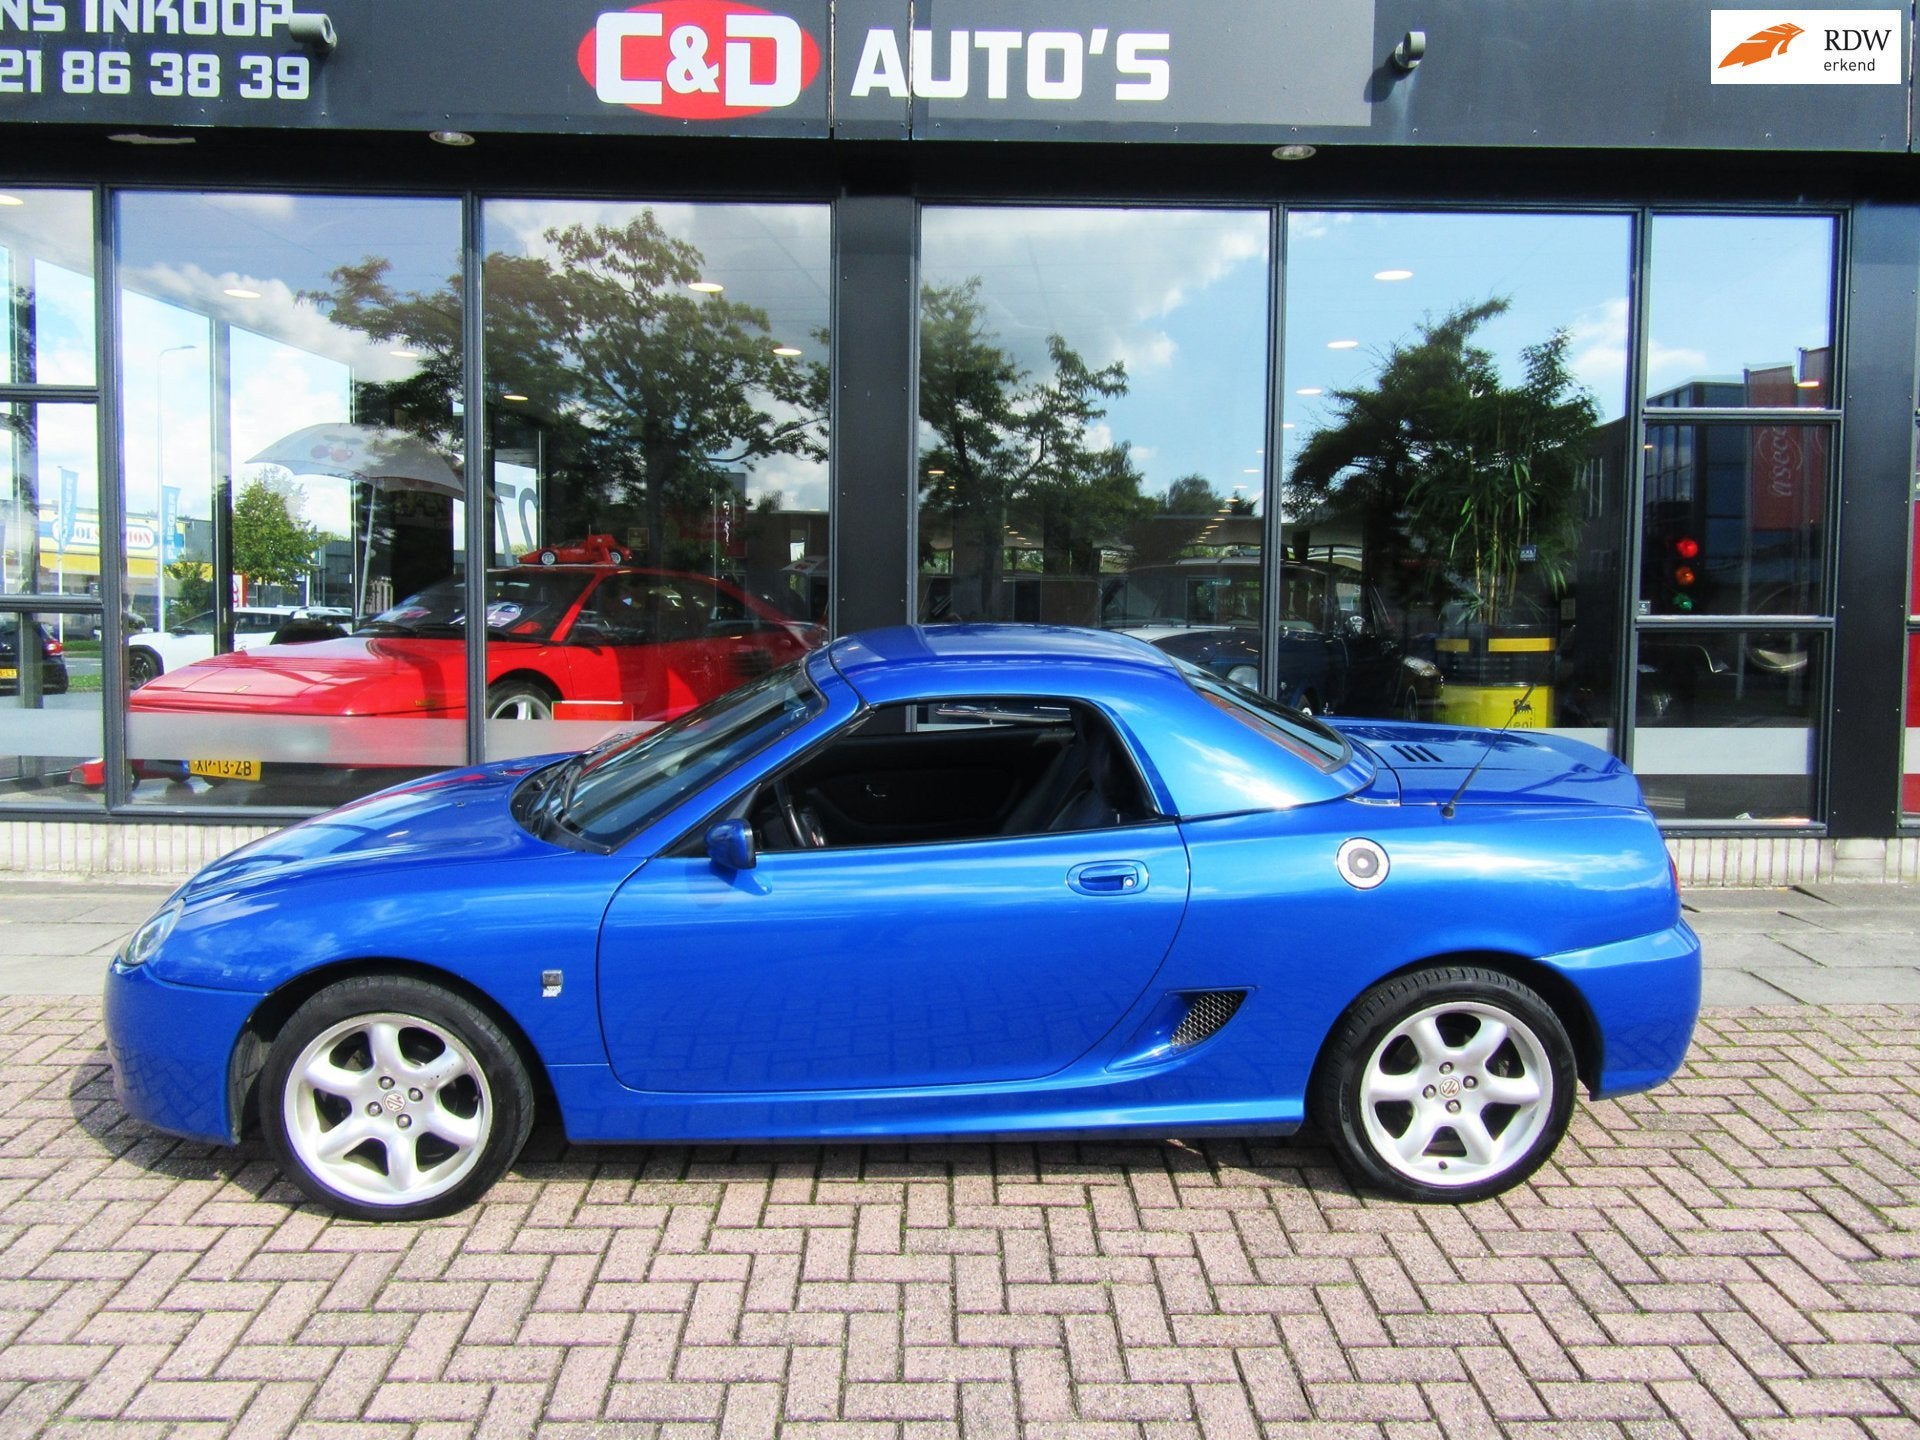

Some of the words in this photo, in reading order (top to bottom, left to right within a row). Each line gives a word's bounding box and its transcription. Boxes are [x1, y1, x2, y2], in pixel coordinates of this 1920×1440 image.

[85, 0, 293, 37] INKOOP
[0, 50, 42, 93] 21
[62, 51, 131, 95] 86
[150, 53, 220, 98] 38
[240, 55, 310, 100] 39
[596, 12, 801, 107] C&D
[851, 28, 1171, 102] AUTO'S
